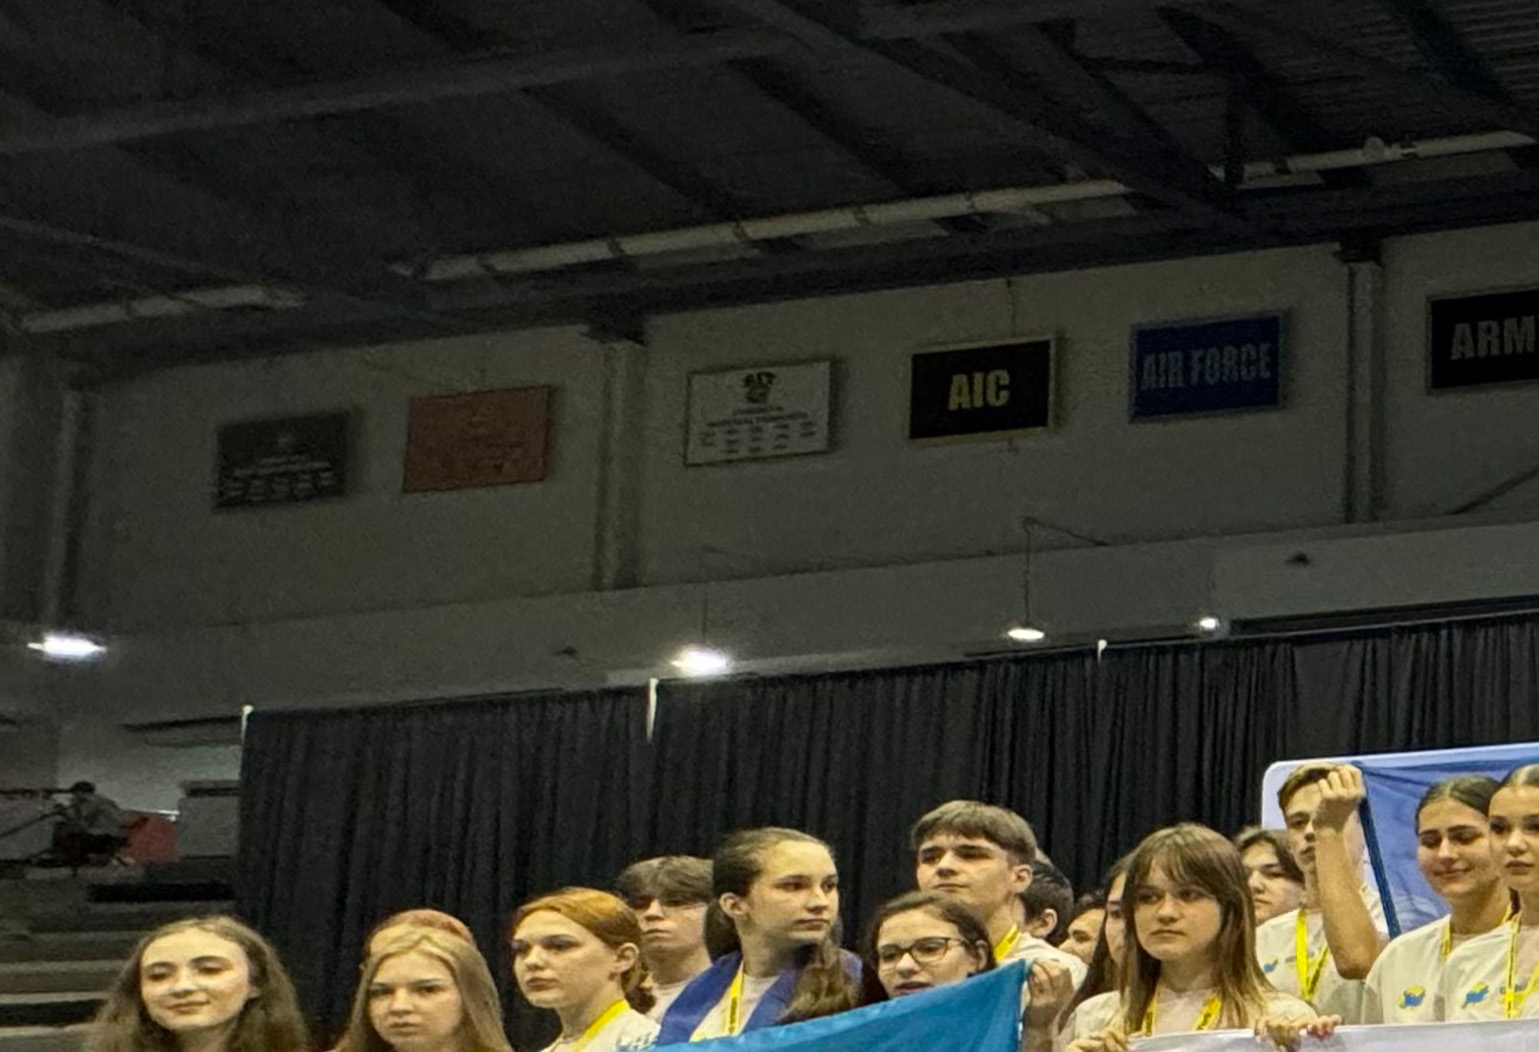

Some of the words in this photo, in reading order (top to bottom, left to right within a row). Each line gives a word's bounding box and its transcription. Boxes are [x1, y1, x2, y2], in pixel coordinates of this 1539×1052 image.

[1141, 351, 1186, 390] AIR
[1191, 342, 1272, 386] FORCE
[947, 369, 1011, 410] AIC
